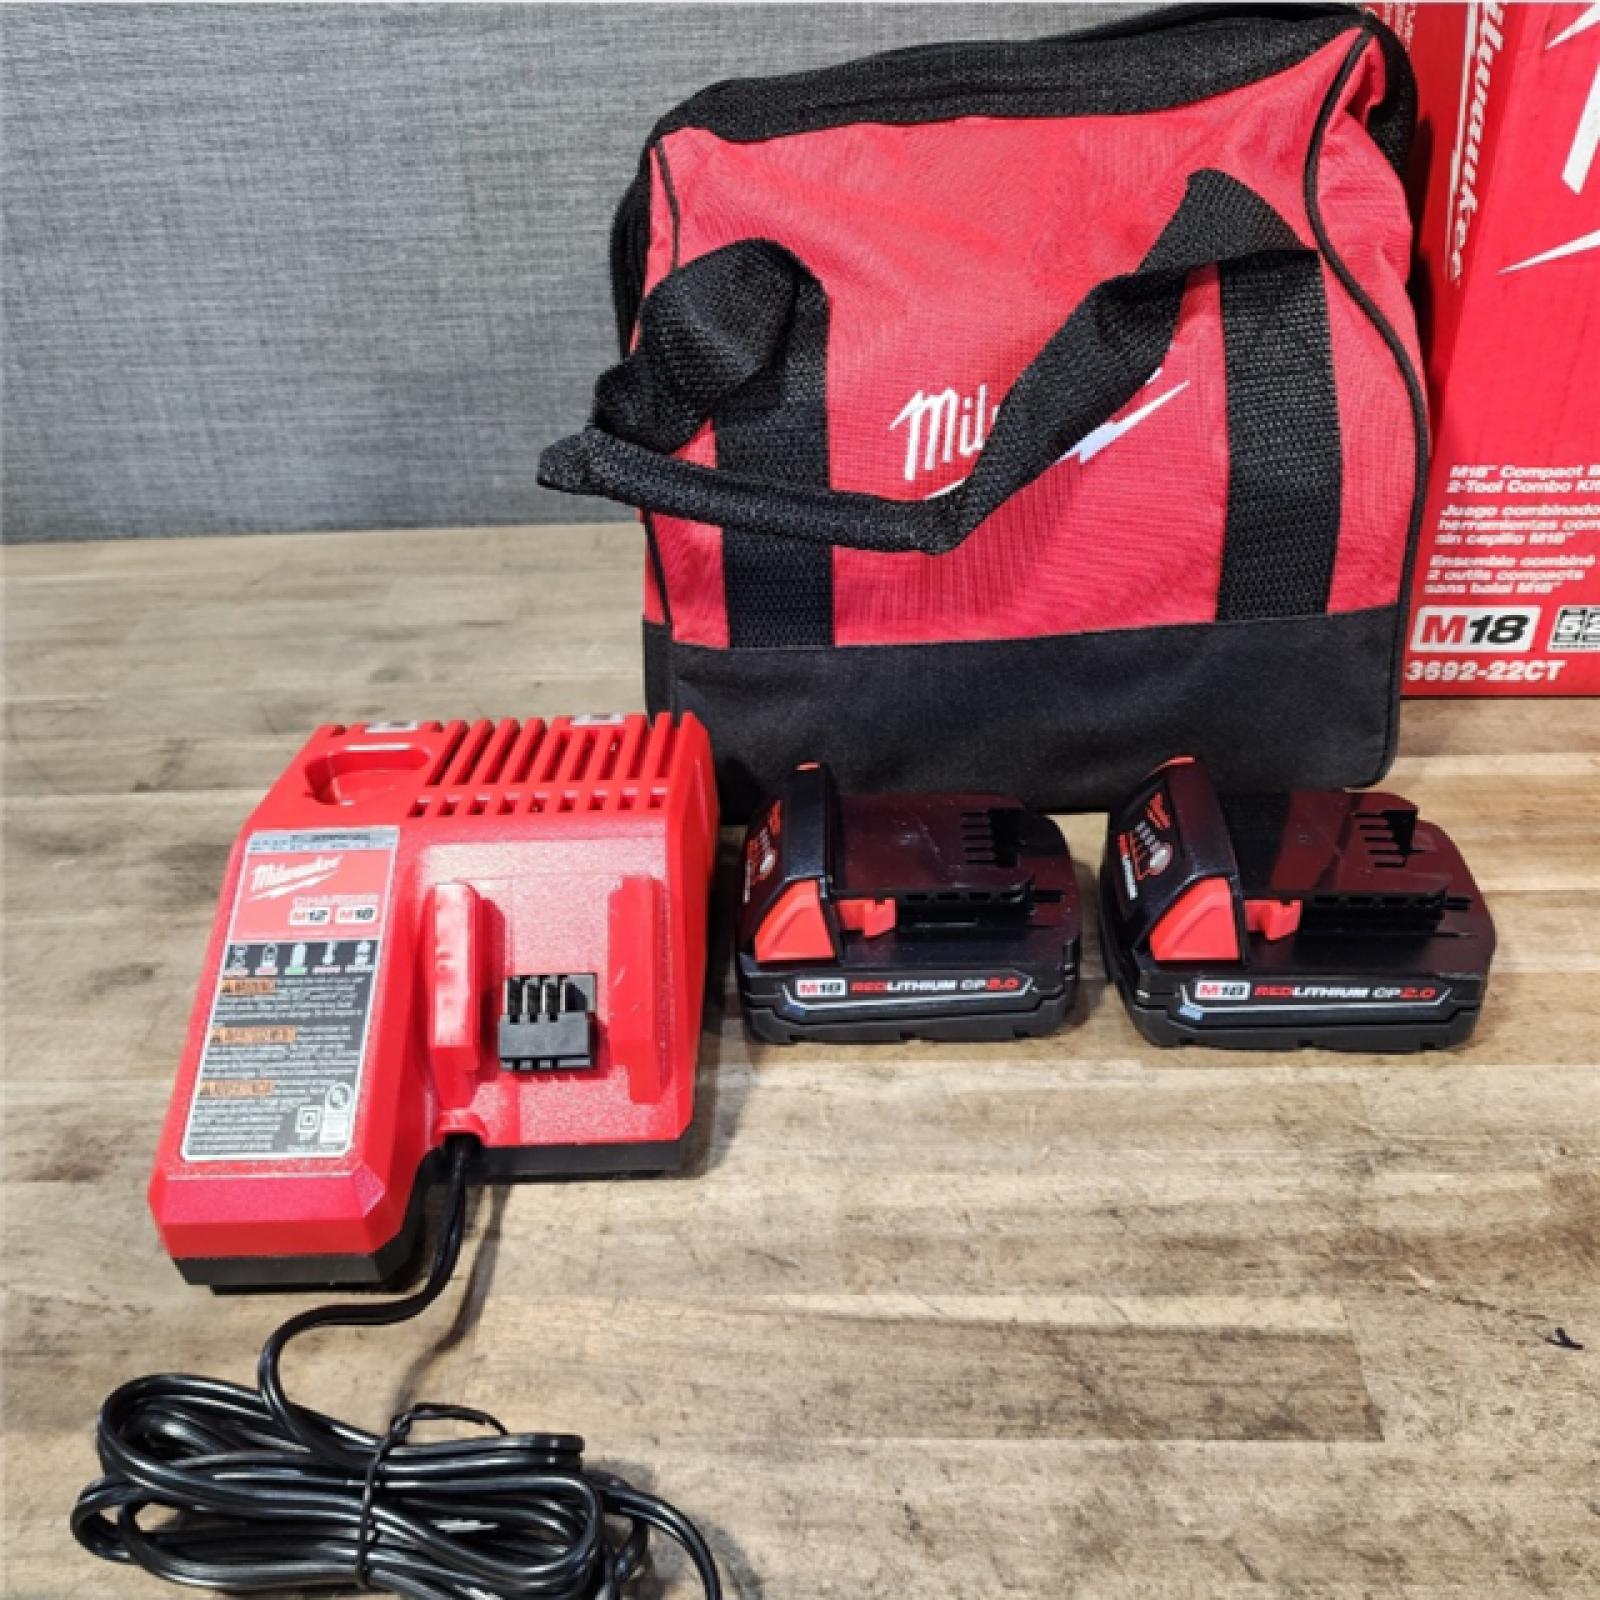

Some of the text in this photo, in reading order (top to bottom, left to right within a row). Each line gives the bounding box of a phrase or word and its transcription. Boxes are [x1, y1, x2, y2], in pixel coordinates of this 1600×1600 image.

[1452, 3, 1503, 287] ilwaukee
[1500, 464, 1583, 480] Compact
[1507, 480, 1571, 494] Combo
[1419, 614, 1530, 645] M18
[1405, 659, 1567, 681] 3692-22CT
[799, 981, 844, 994] M18
[851, 980, 956, 993] REDLITHIUM
[1199, 984, 1246, 996] M18
[1253, 985, 1370, 997] REDLITHIUM
